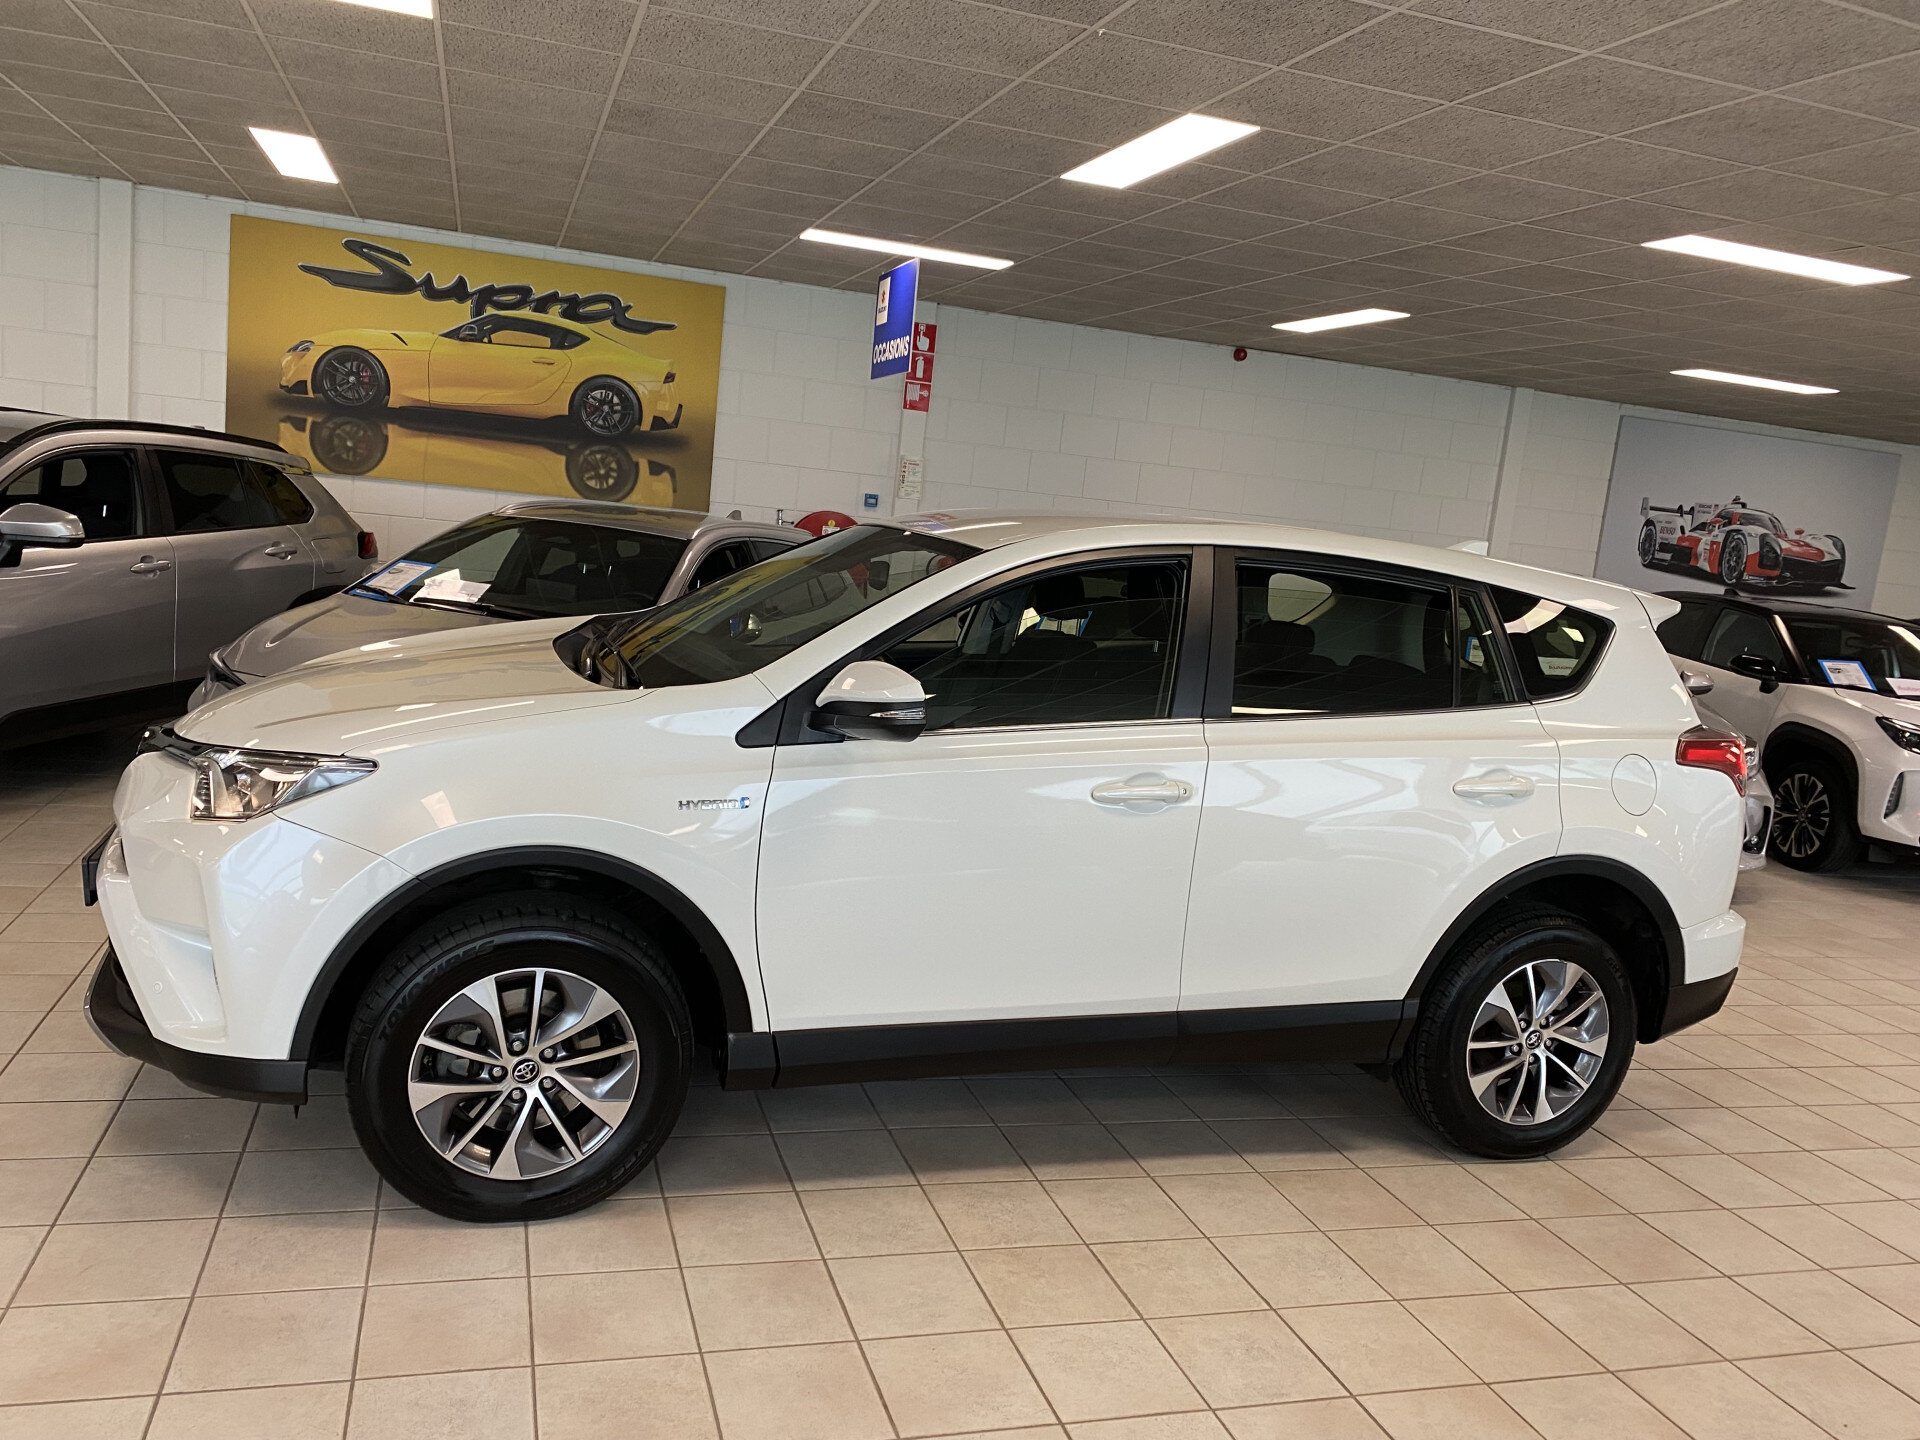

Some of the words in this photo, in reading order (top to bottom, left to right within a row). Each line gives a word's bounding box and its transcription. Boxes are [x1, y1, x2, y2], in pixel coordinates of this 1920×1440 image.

[297, 237, 679, 335] Supra
[873, 335, 910, 364] OCCASIONS
[678, 799, 739, 810] HYBRID
